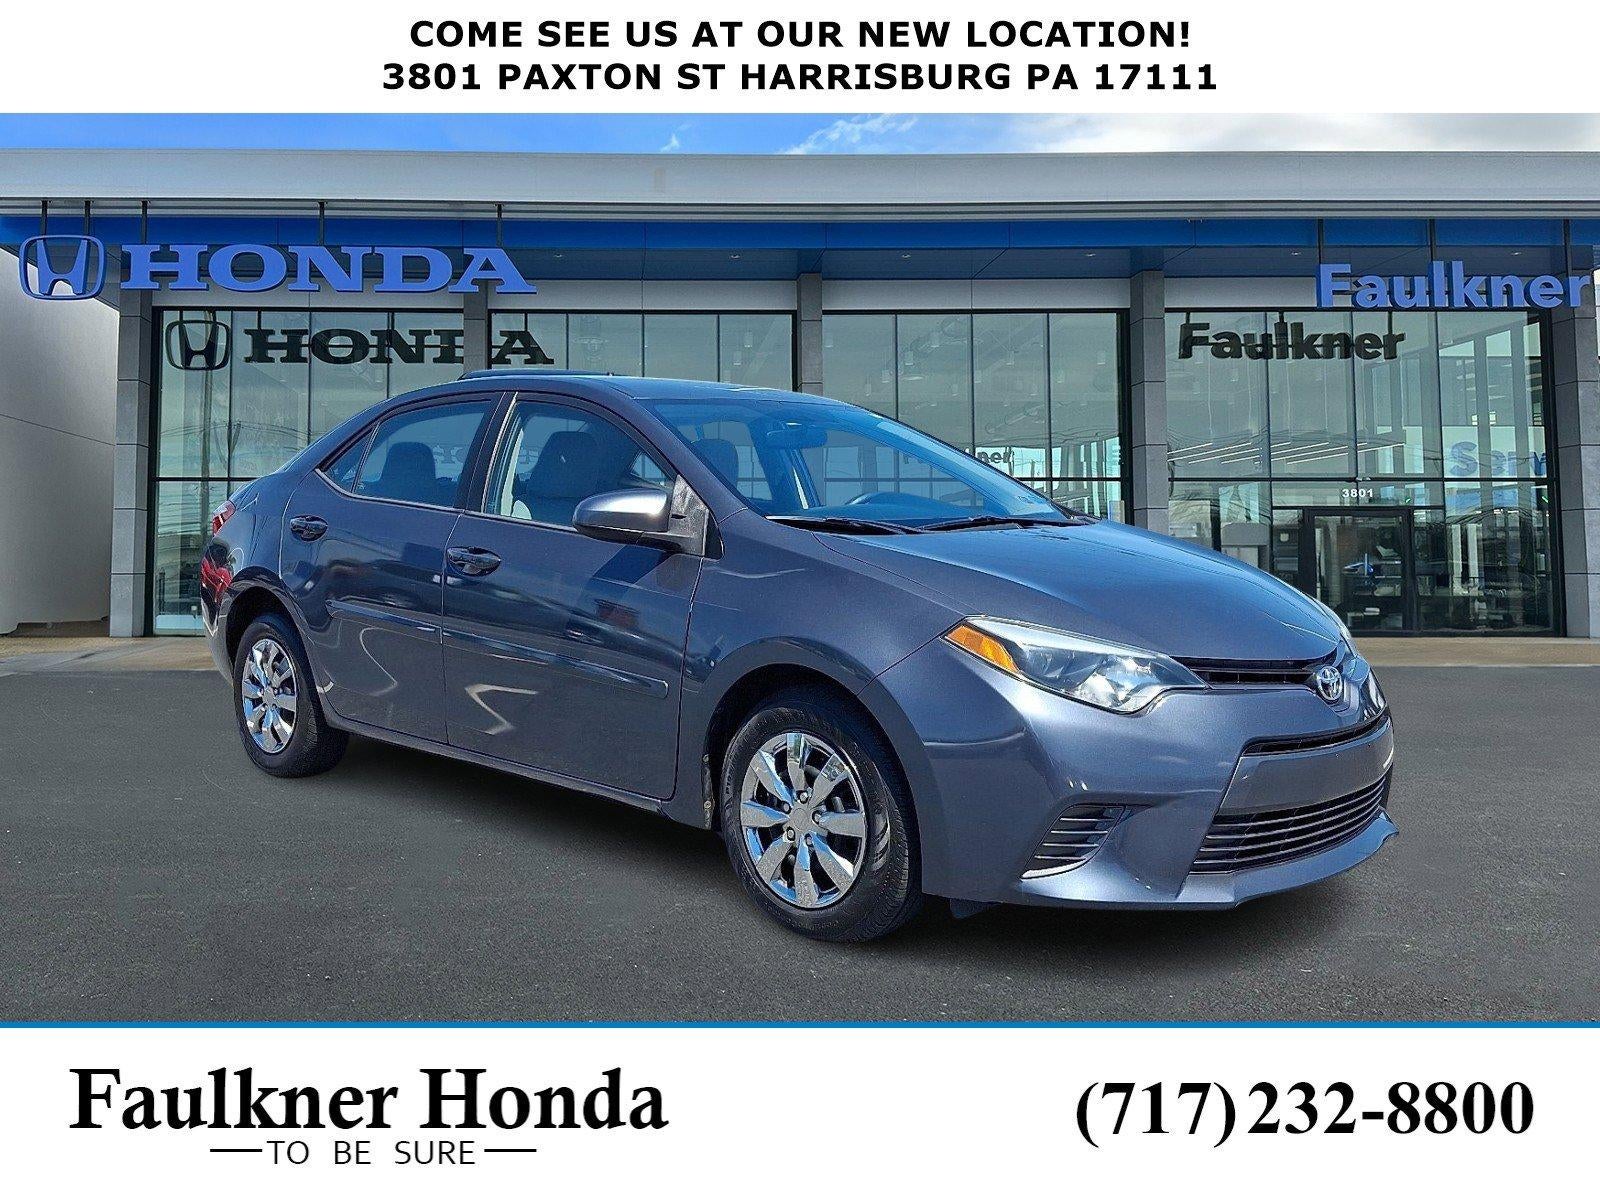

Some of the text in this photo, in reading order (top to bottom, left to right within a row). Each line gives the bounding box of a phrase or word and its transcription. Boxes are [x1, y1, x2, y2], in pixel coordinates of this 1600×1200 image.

[120, 243, 538, 294] HONDA
[1316, 260, 1591, 310] Faulkner
[1178, 321, 1405, 361] Faulkner
[1342, 488, 1373, 498] 3801
